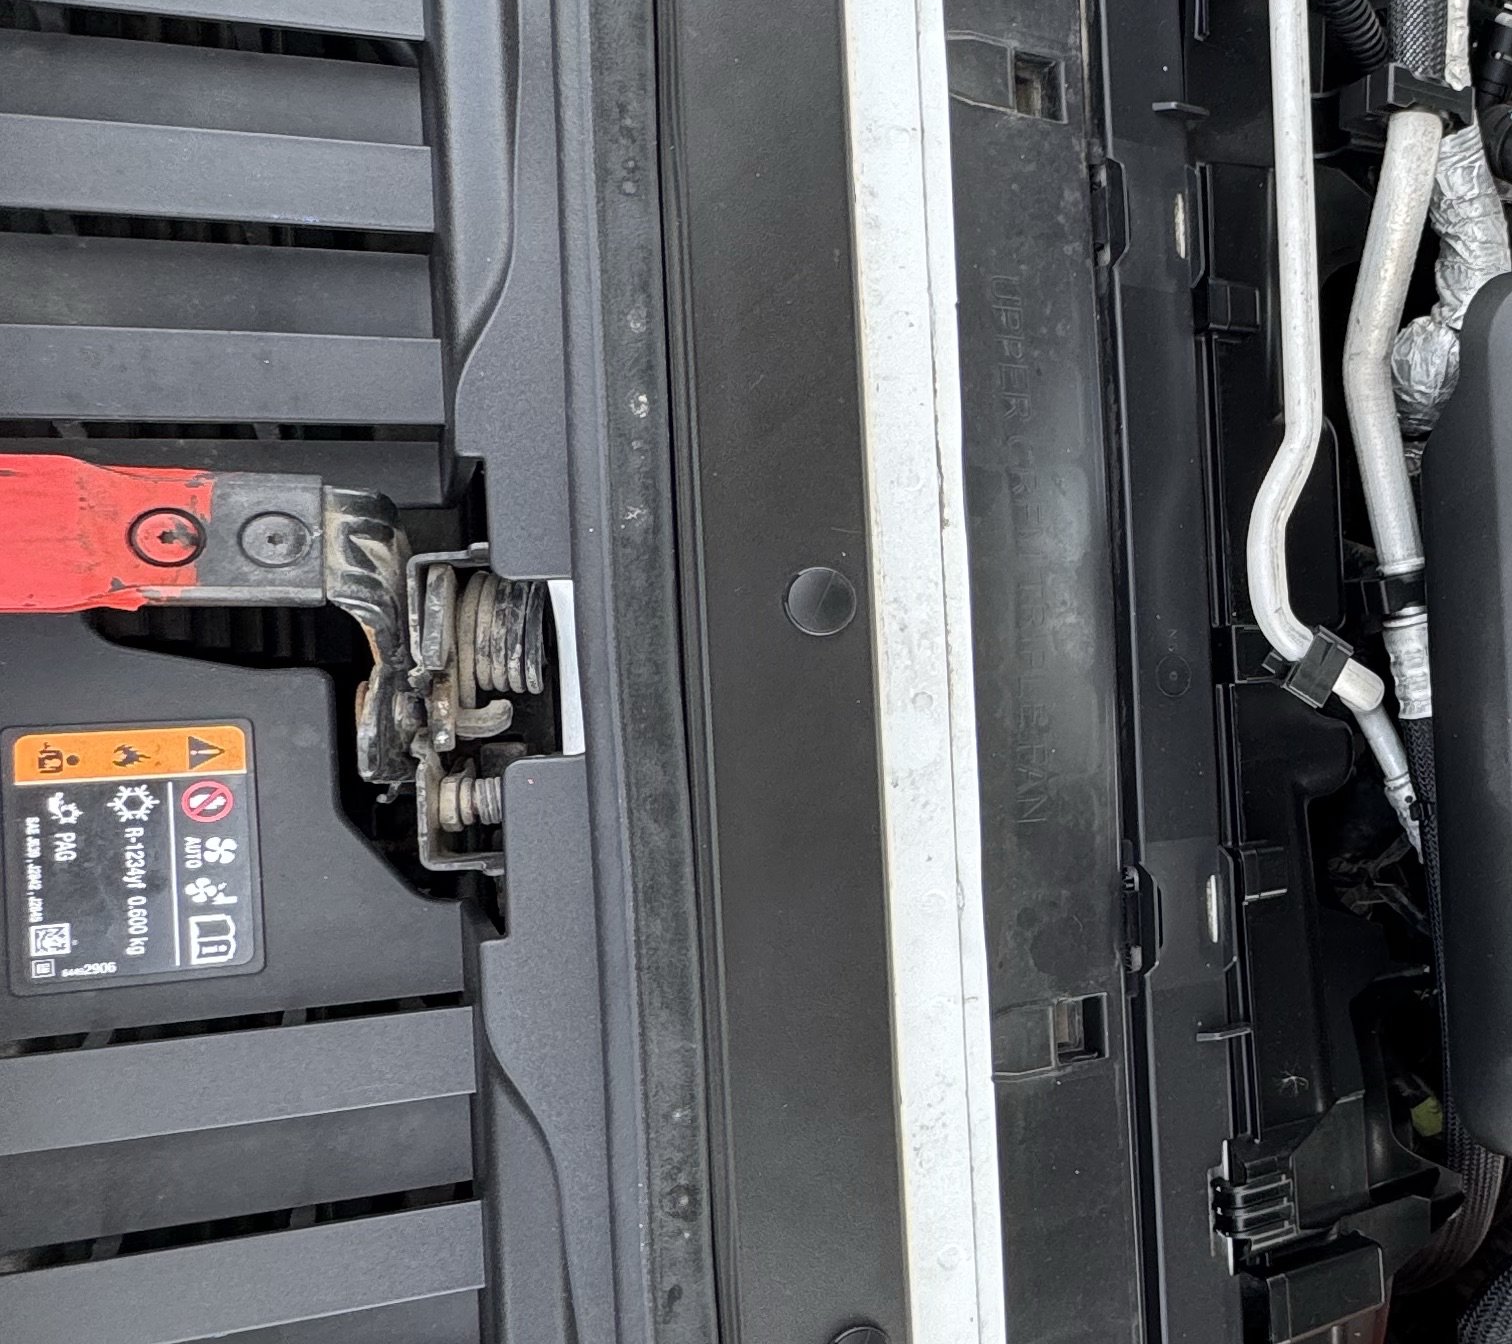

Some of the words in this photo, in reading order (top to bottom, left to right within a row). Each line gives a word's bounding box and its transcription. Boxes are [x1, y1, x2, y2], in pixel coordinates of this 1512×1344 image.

[991, 274, 1032, 423] UPPER
[1014, 743, 1050, 825] FAN
[53, 832, 77, 862] PAG
[122, 827, 147, 889] R-1234yf
[184, 836, 202, 869] AUTO
[126, 896, 148, 935] 0.600
[125, 937, 148, 956] kg
